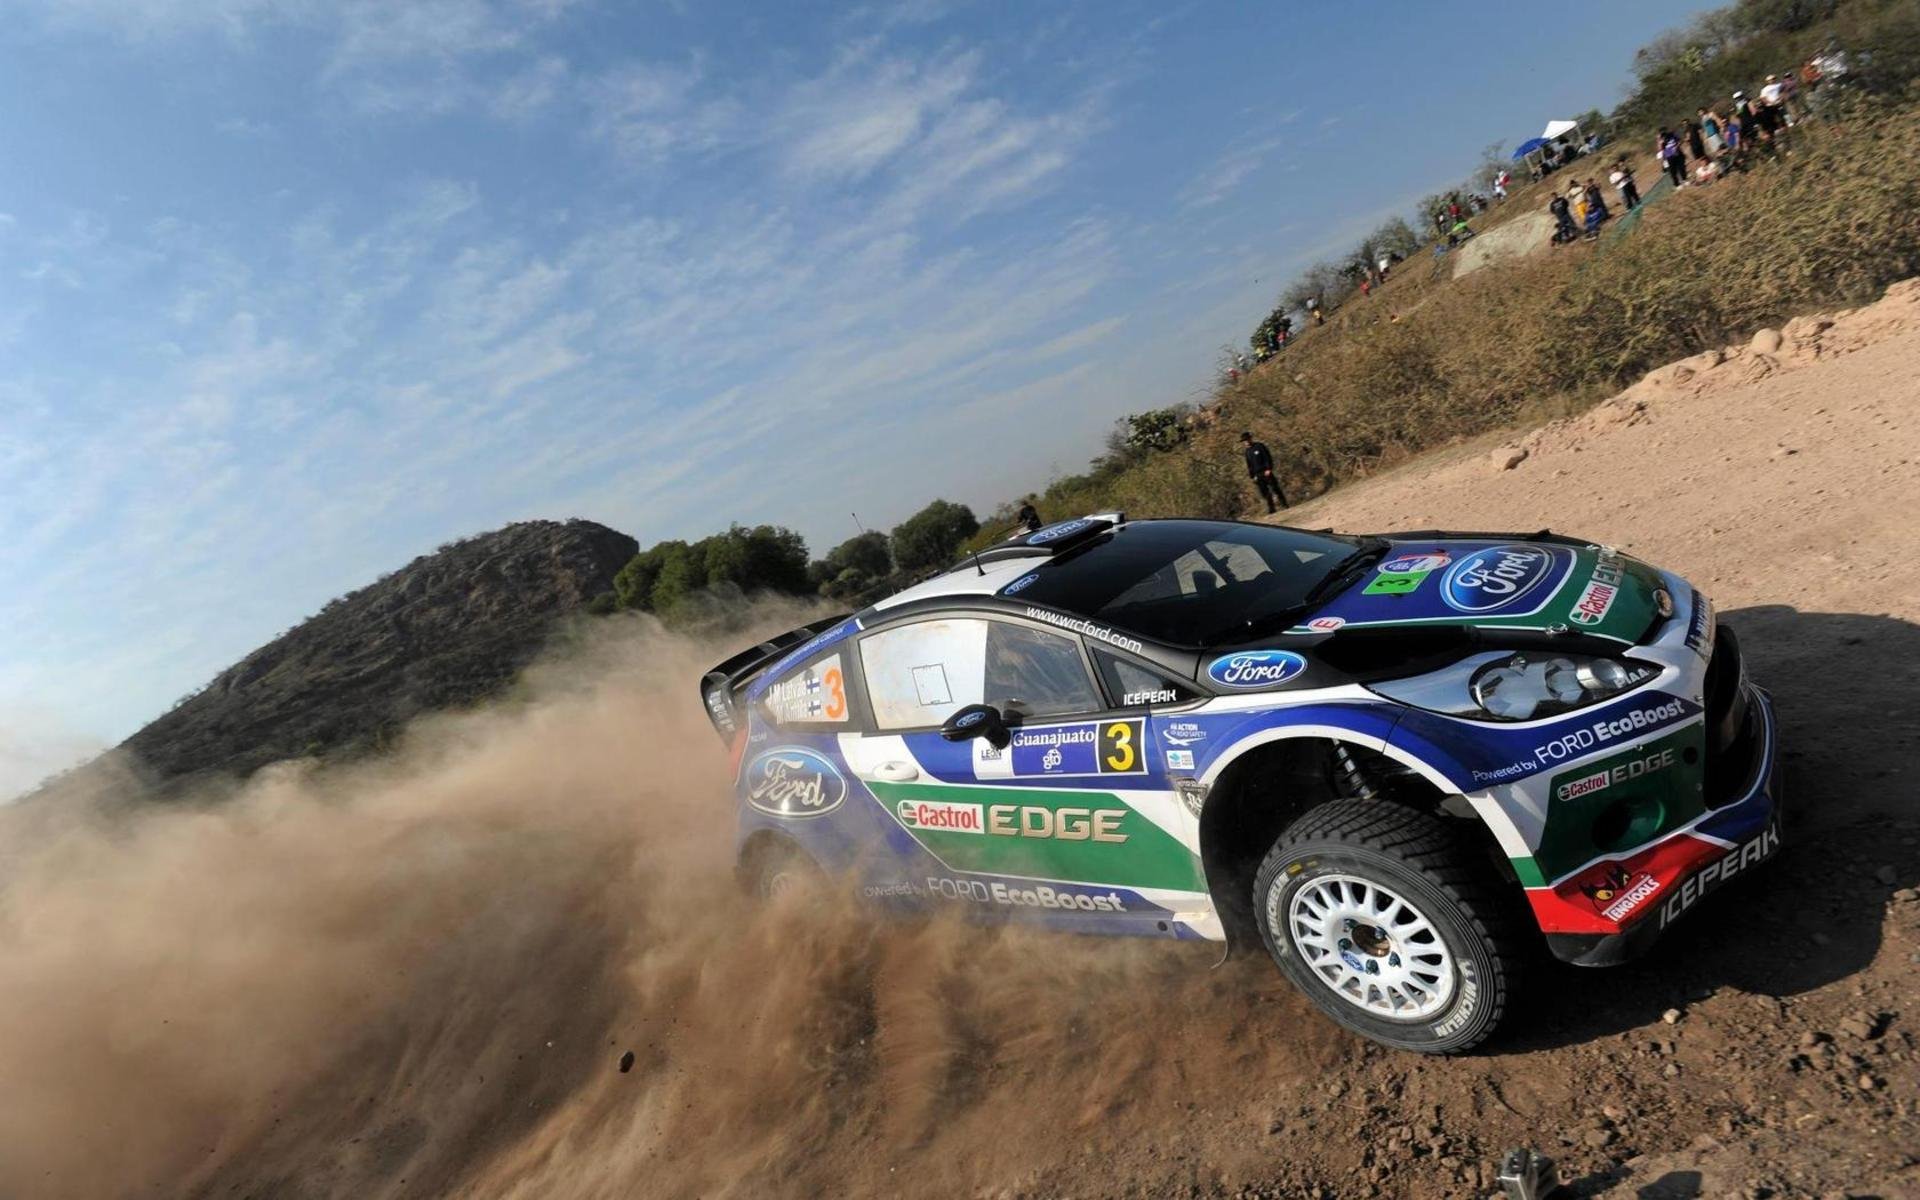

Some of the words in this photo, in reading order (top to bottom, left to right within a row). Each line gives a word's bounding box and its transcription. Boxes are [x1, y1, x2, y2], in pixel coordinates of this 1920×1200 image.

[1376, 579, 1411, 587] 3
[1455, 551, 1542, 594] Ford
[1579, 583, 1613, 616] Castrol
[1026, 606, 1142, 653] www.wrcford.com
[1315, 619, 1339, 630] E
[1224, 655, 1287, 682] Ford
[1613, 667, 1648, 689] PIAA
[823, 667, 845, 719] 3
[1123, 688, 1177, 706] ICEPEAK
[1012, 728, 1096, 748] Guanajuato
[1106, 722, 1135, 771] 3
[1472, 762, 1522, 782] Powered
[1522, 758, 1538, 774] by
[1535, 728, 1594, 764] FORD
[1593, 698, 1686, 742] EcoBoost
[753, 758, 826, 807] Ford
[1570, 773, 1608, 797] Castrol
[1611, 748, 1675, 784] EDGE
[918, 803, 980, 830] Castrol
[988, 804, 1131, 843] EDGE
[926, 877, 990, 903] FORD
[990, 881, 1127, 913] EcoBoost
[1659, 823, 1780, 931] ICEPEAK
[1434, 982, 1478, 1038] MICHELIN
